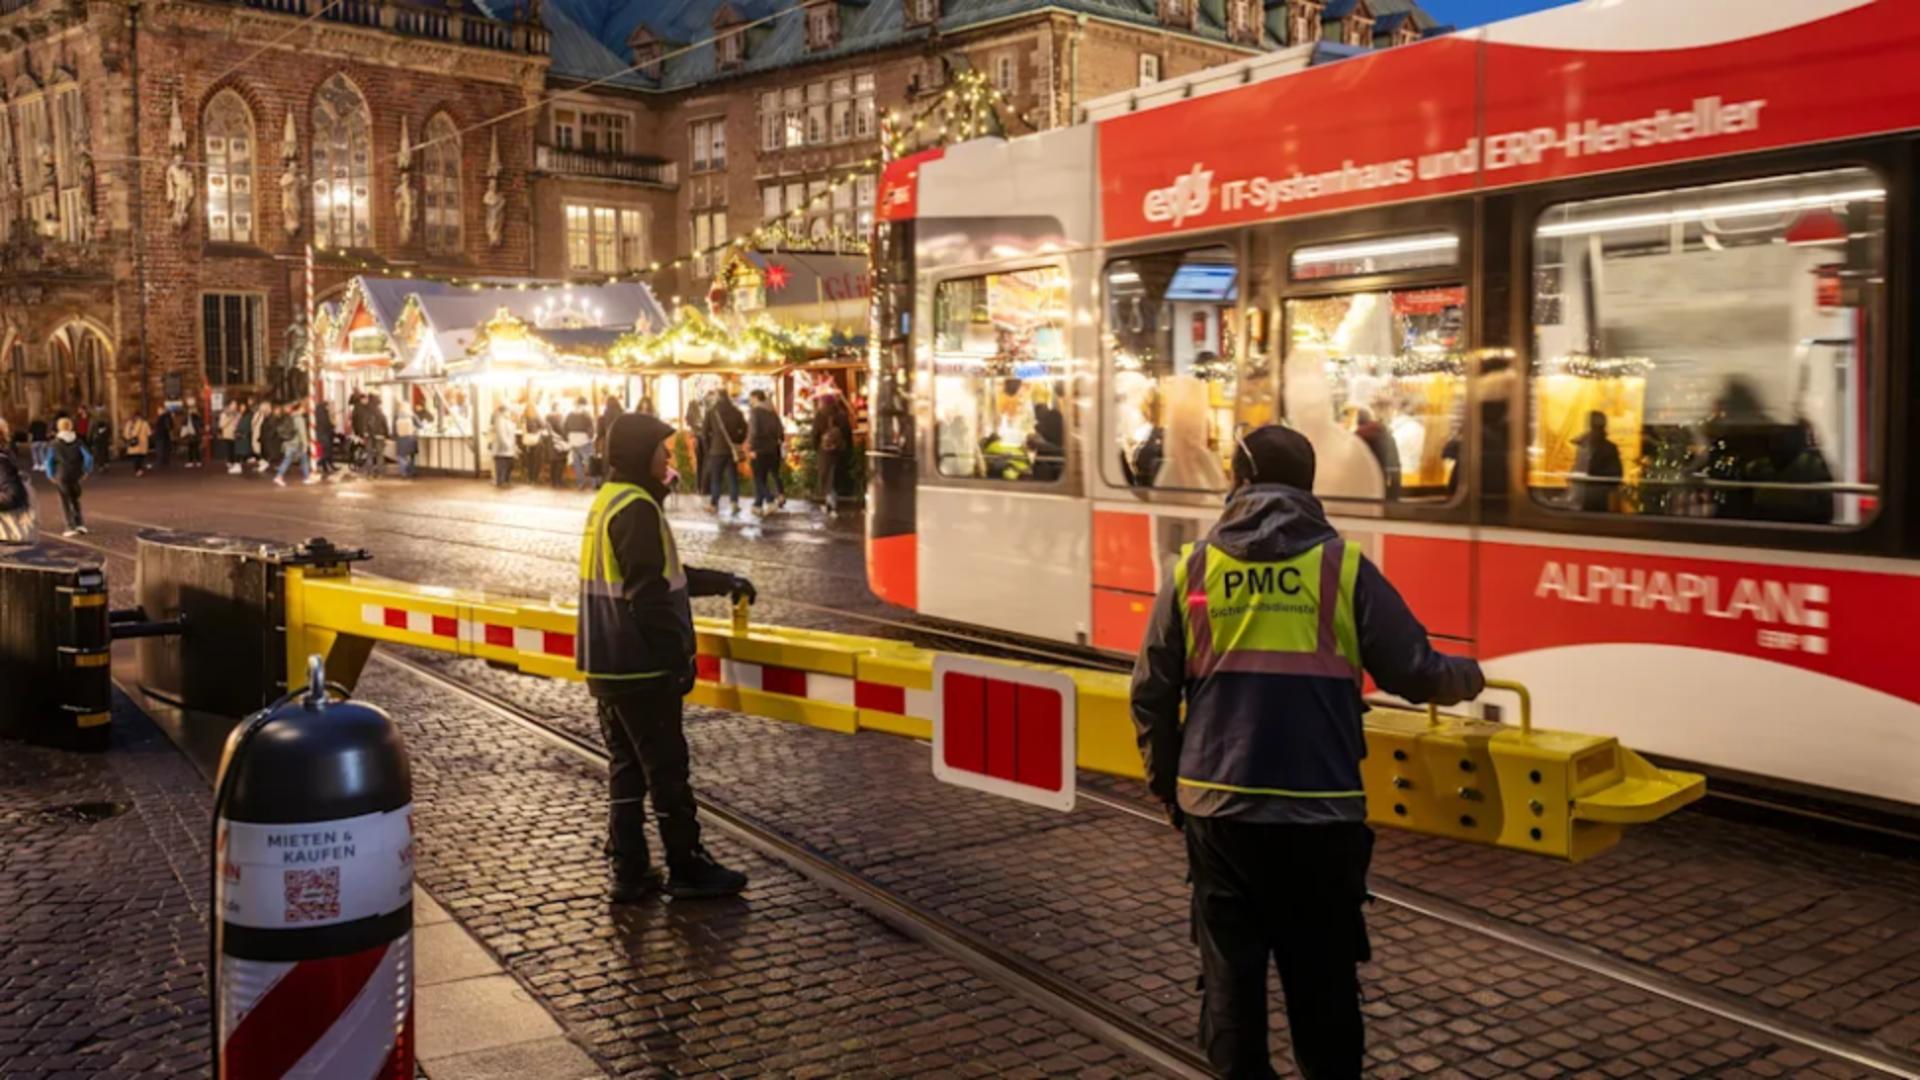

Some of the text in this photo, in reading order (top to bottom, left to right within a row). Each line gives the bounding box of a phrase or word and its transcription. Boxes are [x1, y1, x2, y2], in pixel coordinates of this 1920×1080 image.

[1220, 158, 1414, 212] IT-Systemhaus
[1418, 137, 1481, 180] und
[1484, 96, 1768, 170] ERP-Hersteller
[1223, 567, 1302, 599] PMC
[1534, 561, 1807, 626] ALPHAPLAN
[266, 831, 354, 848] MIETEN &
[282, 844, 356, 864] KAUFEN
